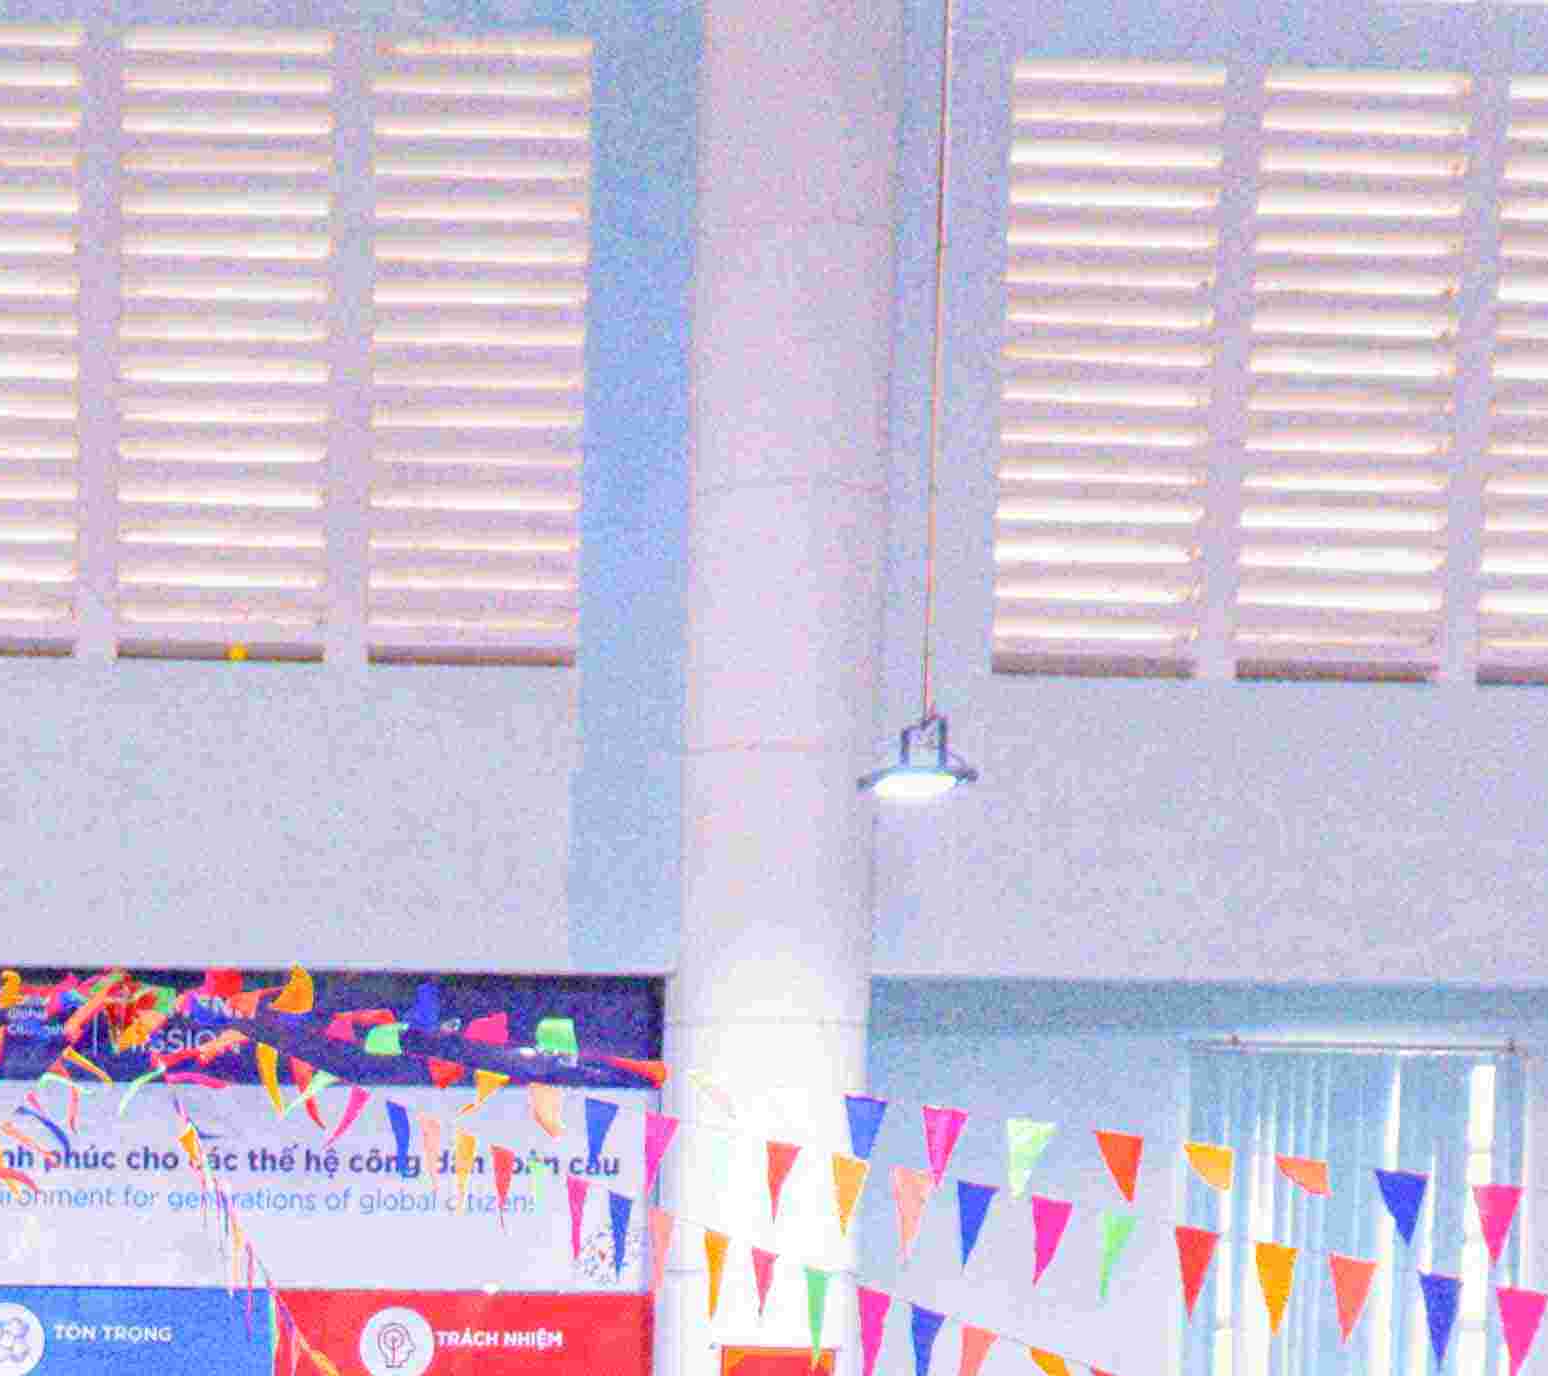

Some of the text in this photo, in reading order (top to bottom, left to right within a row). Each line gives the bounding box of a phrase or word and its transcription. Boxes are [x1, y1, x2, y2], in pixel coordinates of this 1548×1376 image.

[126, 1146, 180, 1172] cho
[189, 1146, 239, 1172] ác
[247, 1143, 299, 1173] thế
[305, 1146, 339, 1179] hệ
[123, 1184, 160, 1208] for
[324, 1187, 353, 1211] of
[360, 1188, 437, 1216] global
[53, 1320, 99, 1342] TÔN
[436, 1327, 564, 1349] TRÁCH NHIỆM
